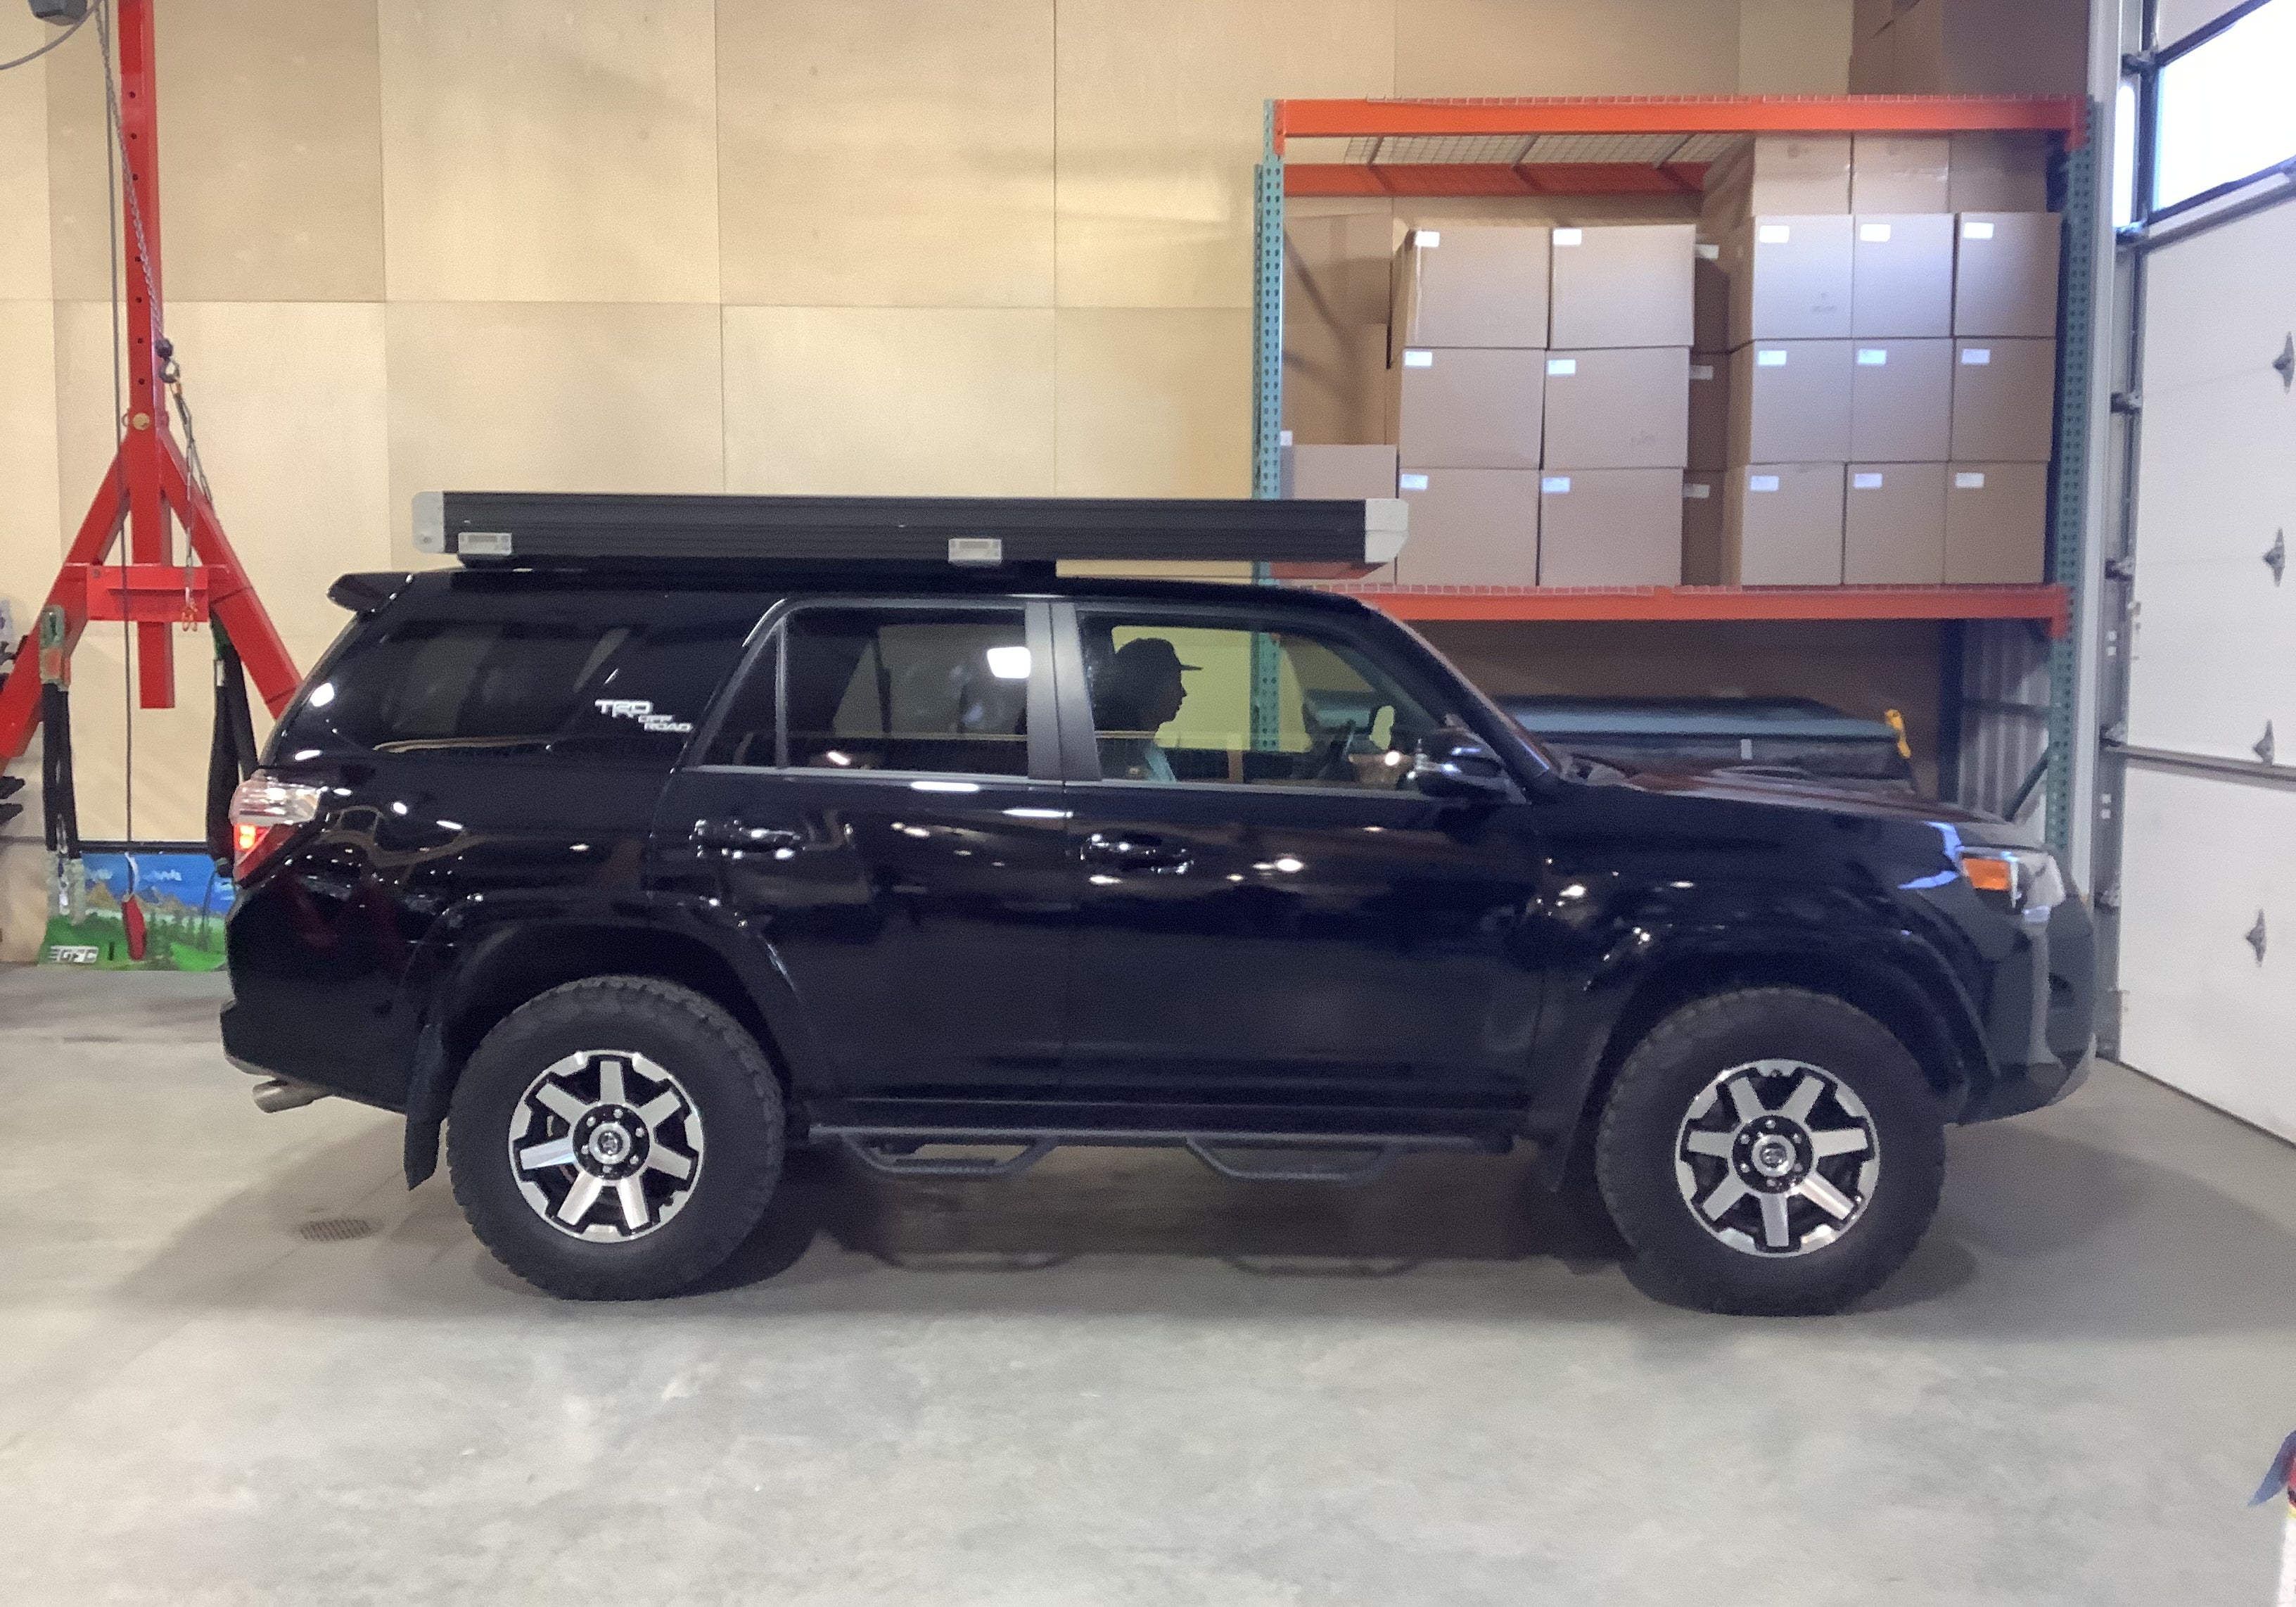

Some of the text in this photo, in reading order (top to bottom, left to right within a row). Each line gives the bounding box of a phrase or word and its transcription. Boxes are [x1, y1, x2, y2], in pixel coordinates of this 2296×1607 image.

[594, 699, 653, 718] TRD
[638, 715, 673, 723] OFF
[644, 723, 693, 732] ROAD
